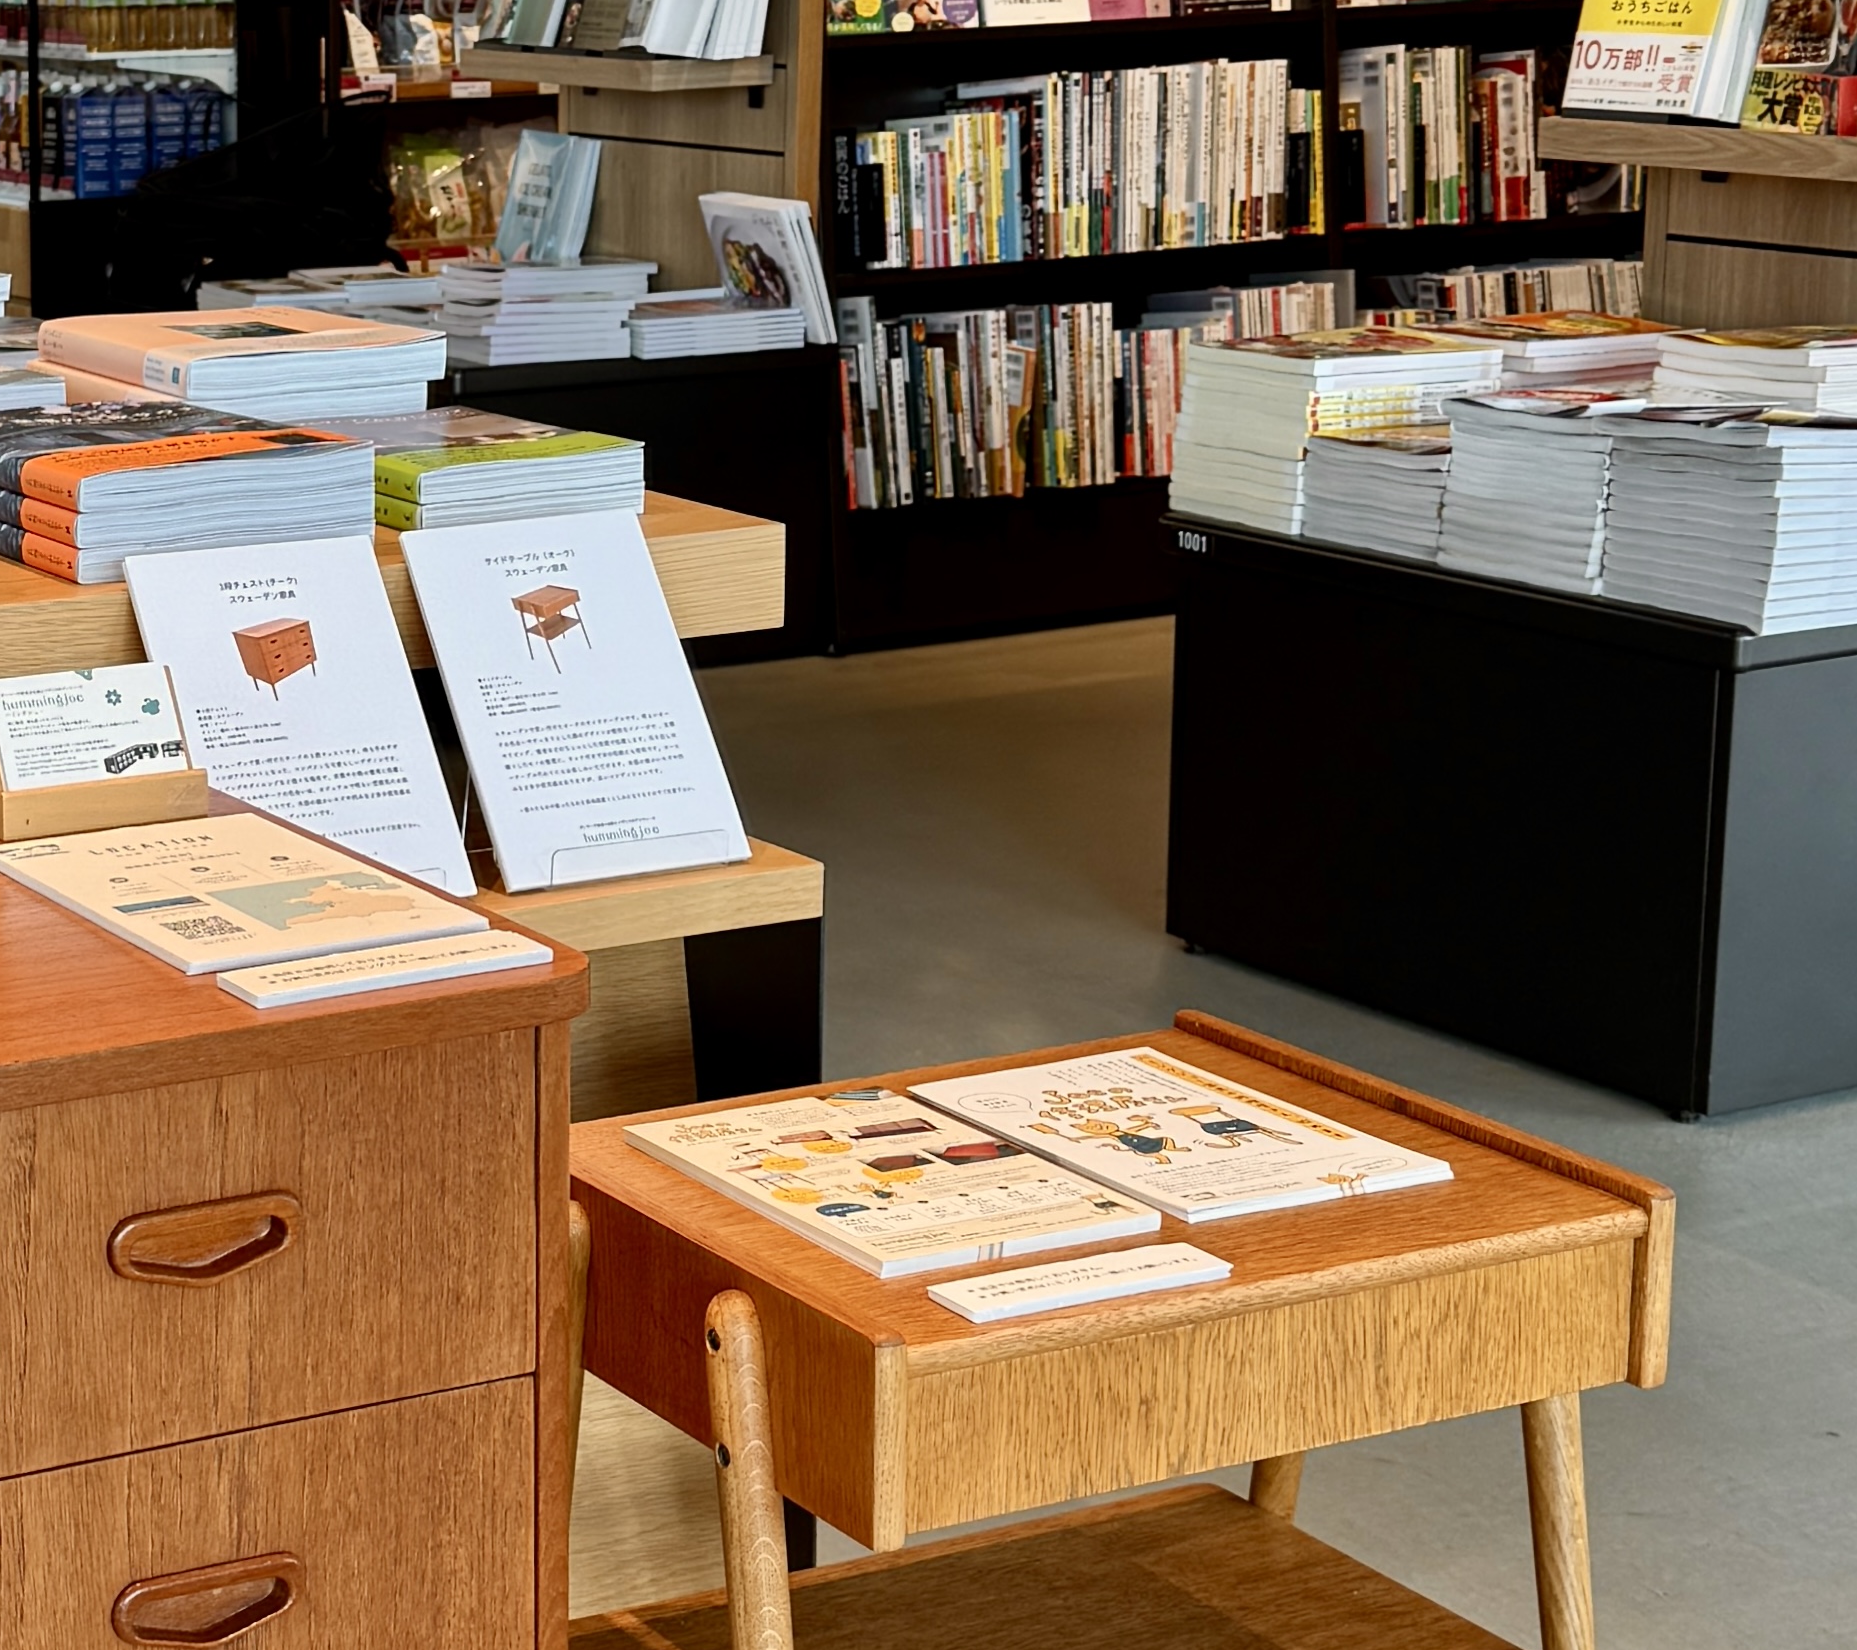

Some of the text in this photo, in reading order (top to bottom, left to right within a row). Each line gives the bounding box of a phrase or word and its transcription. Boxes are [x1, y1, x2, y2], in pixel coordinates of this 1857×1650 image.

[1610, 0, 1694, 15] おうちごはん
[1574, 39, 1661, 73] 10万部!!
[1656, 73, 1694, 94] 受賞
[1757, 92, 1801, 126] 大賞
[1178, 530, 1207, 553] 1001
[88, 834, 214, 856] LOCATION
